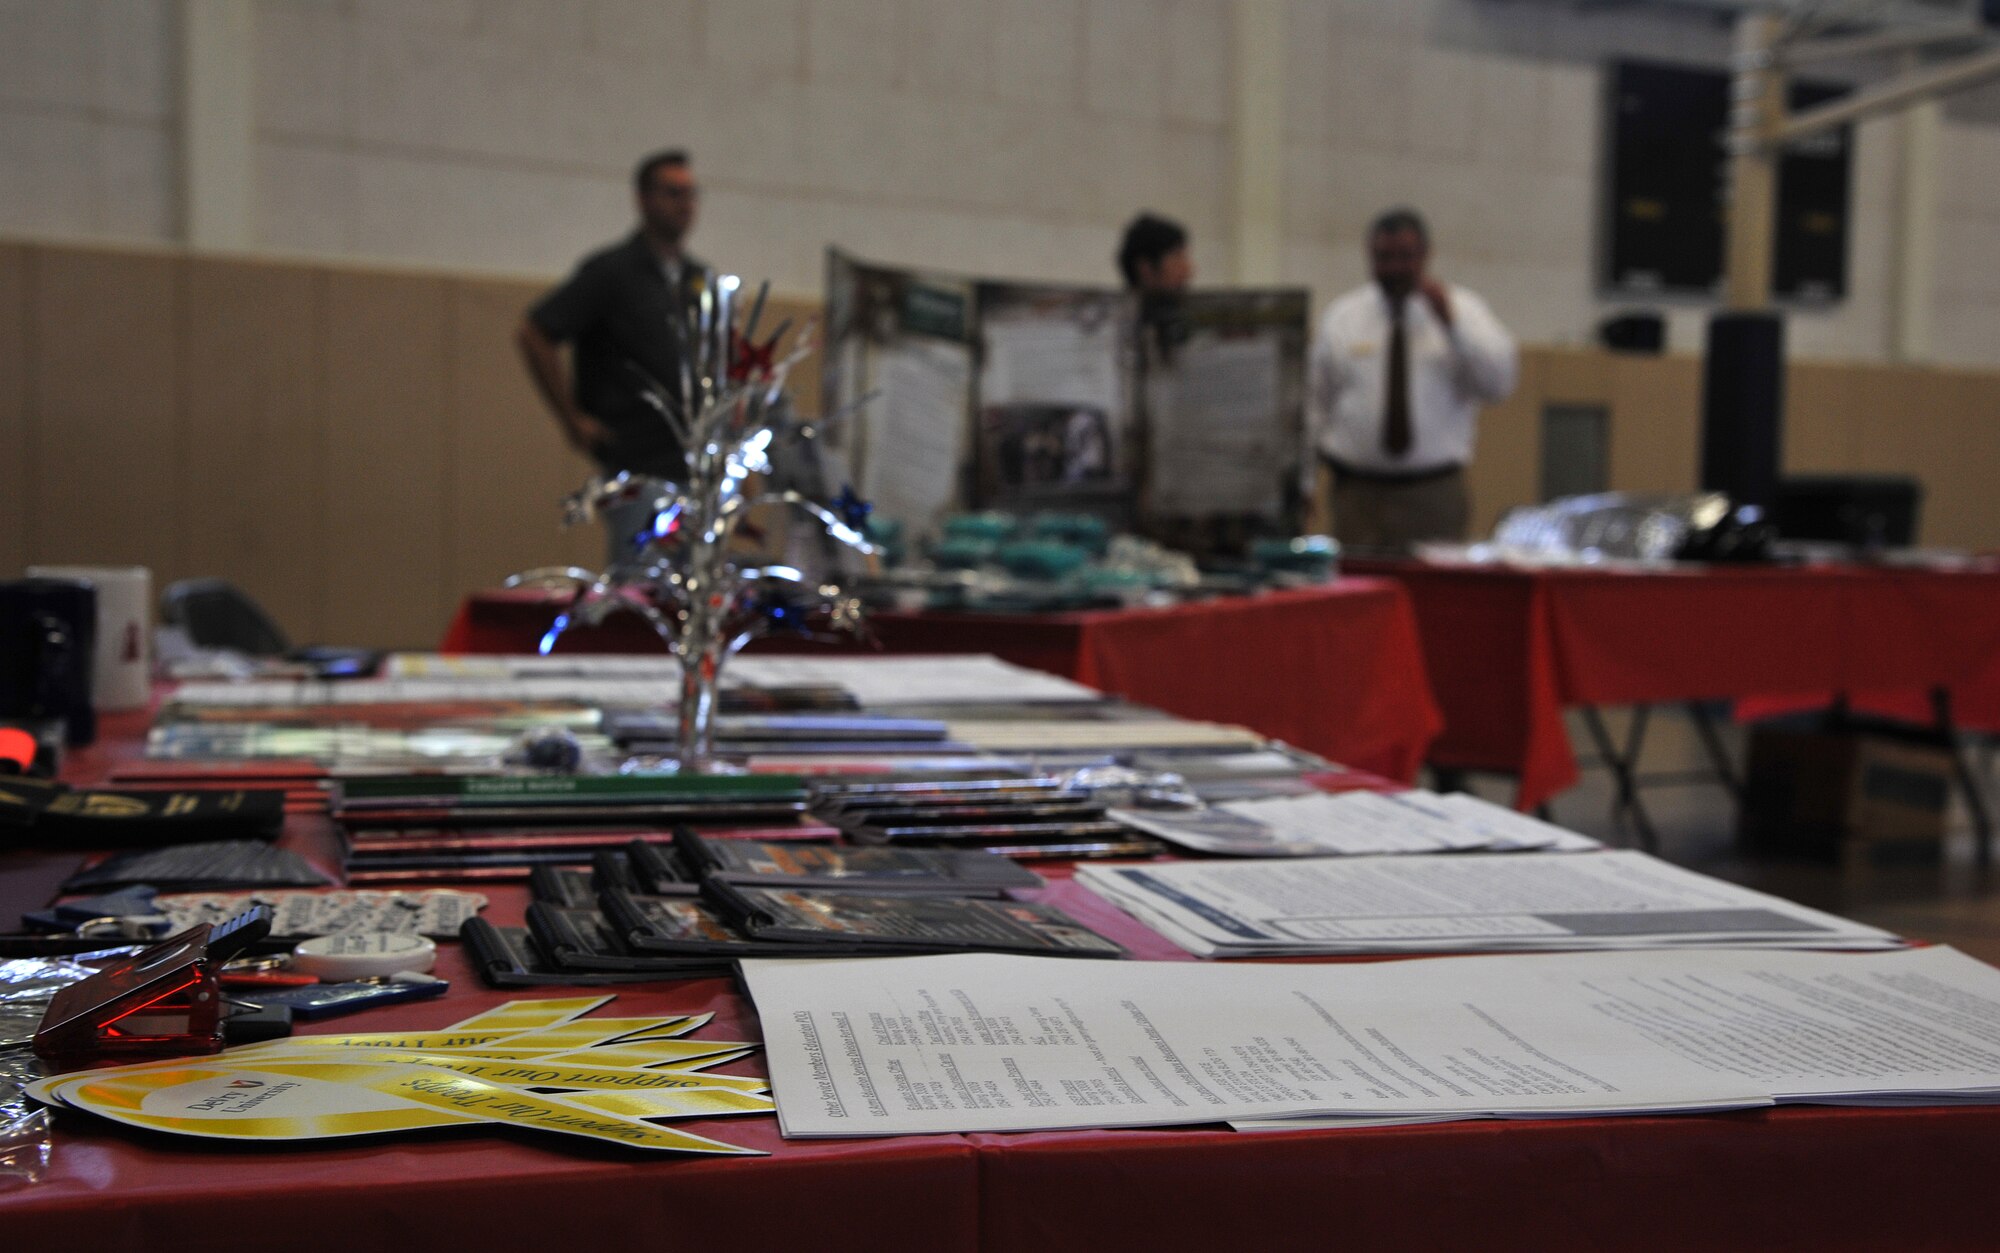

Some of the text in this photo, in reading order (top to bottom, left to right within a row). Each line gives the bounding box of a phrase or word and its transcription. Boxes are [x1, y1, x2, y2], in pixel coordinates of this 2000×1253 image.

[844, 1038, 860, 1057] Division
[793, 1010, 844, 1117] Other Service Members Education POCs
[850, 1057, 867, 1076] Services
[491, 1067, 560, 1082] Our
[570, 1073, 701, 1088] Support
[858, 1076, 876, 1097] Education
[186, 1091, 249, 1110] DeVry
[220, 1081, 302, 1113] University
[400, 1077, 662, 1139] Support Our Troops
